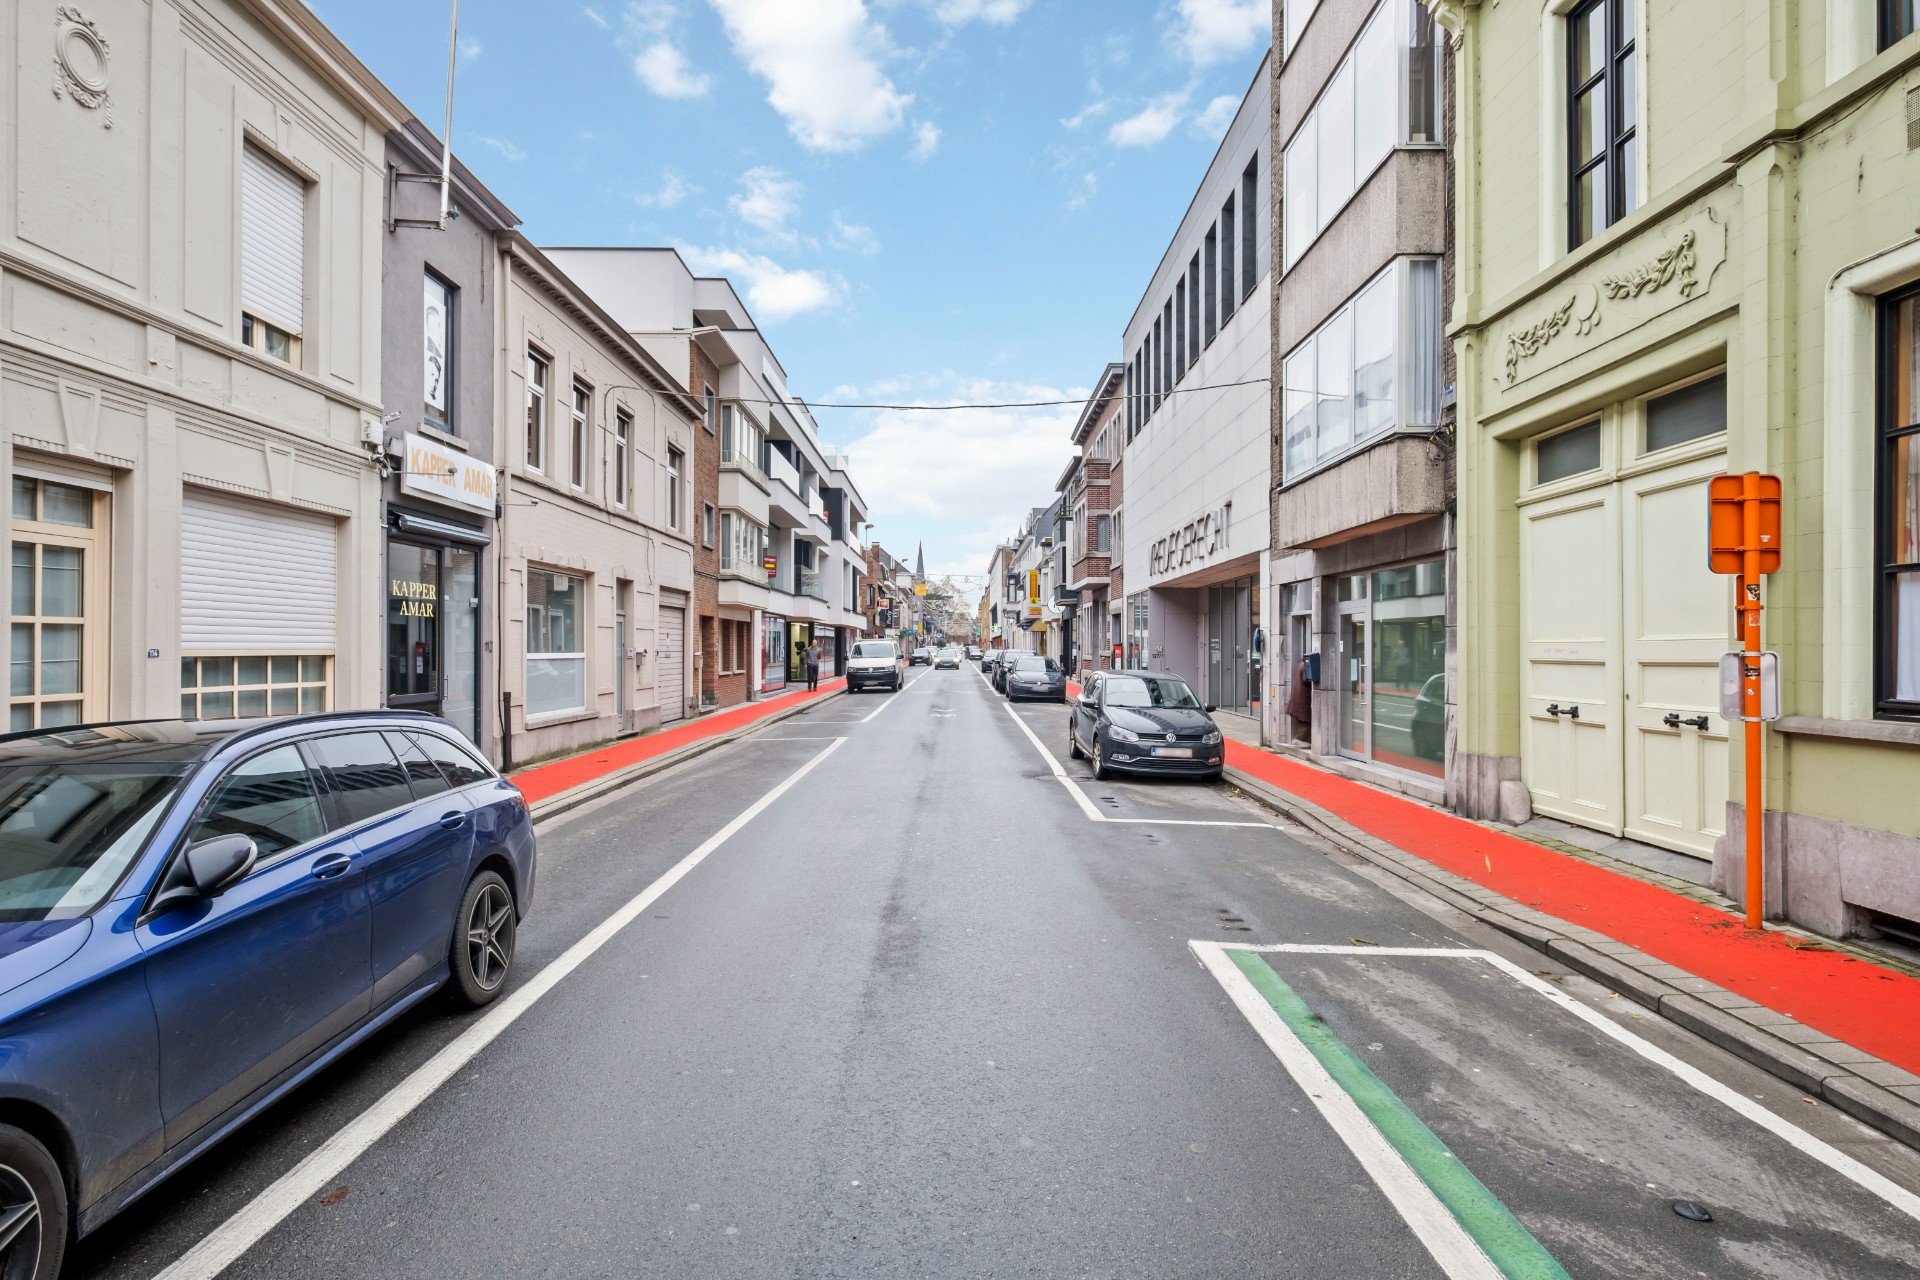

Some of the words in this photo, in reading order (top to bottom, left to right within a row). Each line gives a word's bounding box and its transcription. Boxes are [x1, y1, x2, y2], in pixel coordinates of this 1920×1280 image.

[411, 447, 456, 487] KAPPER
[464, 466, 493, 499] AMAR
[392, 580, 437, 600] KAPPER
[400, 601, 434, 617] AMAR
